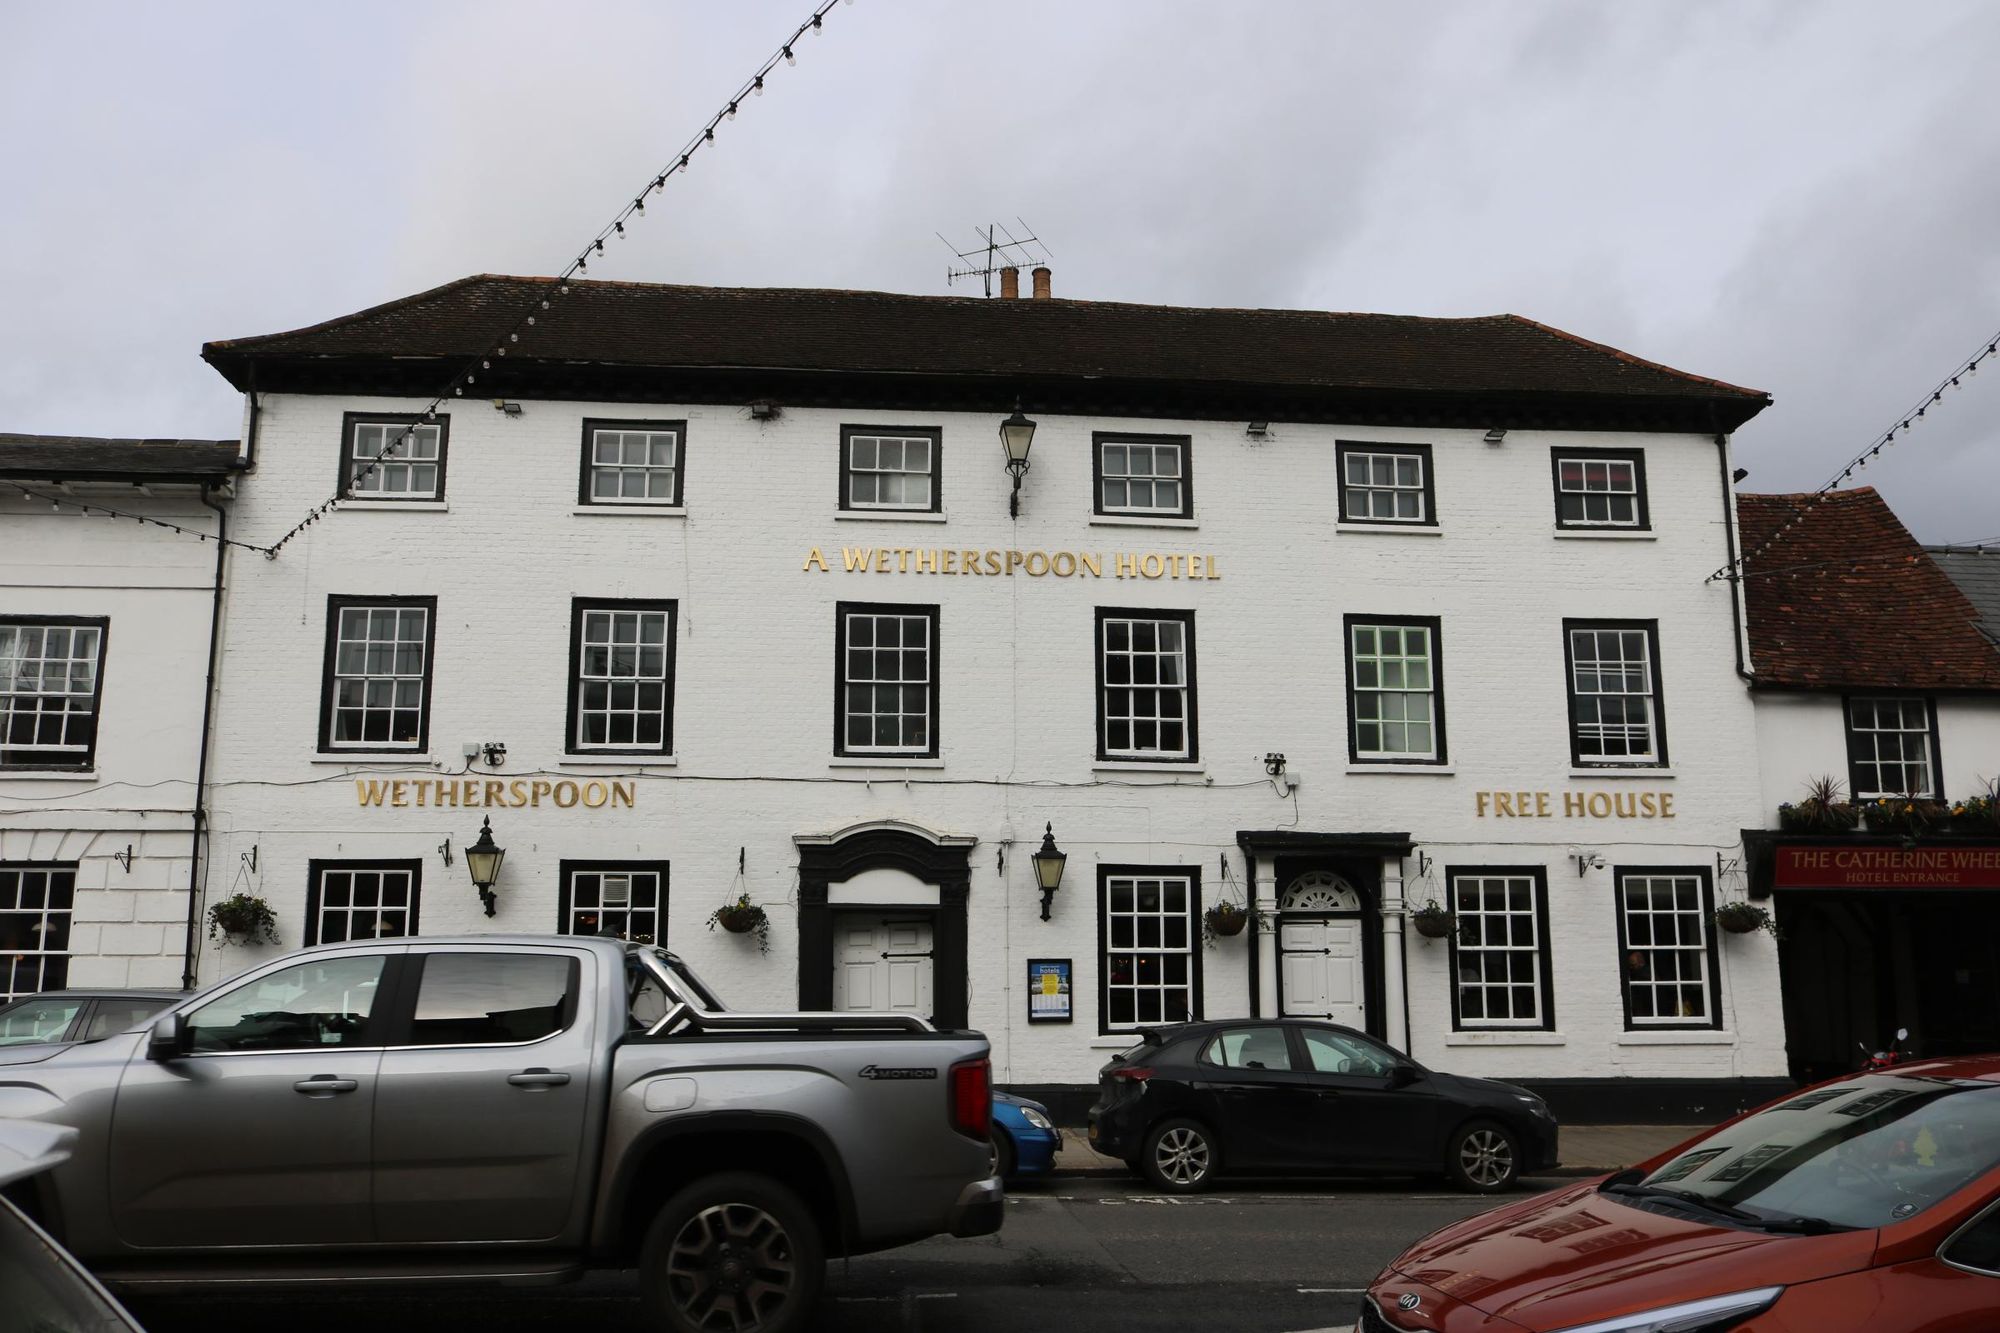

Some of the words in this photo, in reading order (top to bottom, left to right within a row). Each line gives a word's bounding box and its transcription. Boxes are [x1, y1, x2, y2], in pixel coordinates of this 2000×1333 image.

[802, 546, 829, 572] A
[842, 546, 1101, 577] WETHERSPOON
[1115, 552, 1221, 580] HOTEL
[355, 779, 636, 808] WETHERSPOON
[1476, 791, 1553, 818] FREE
[1563, 792, 1677, 819] HOUSE
[1790, 851, 1832, 869] THE
[1835, 851, 1948, 869] CATHERINE
[1846, 872, 1890, 883] HOTEL
[1893, 872, 1960, 883] ENTRANCE
[858, 1065, 937, 1080] 4MOTION
